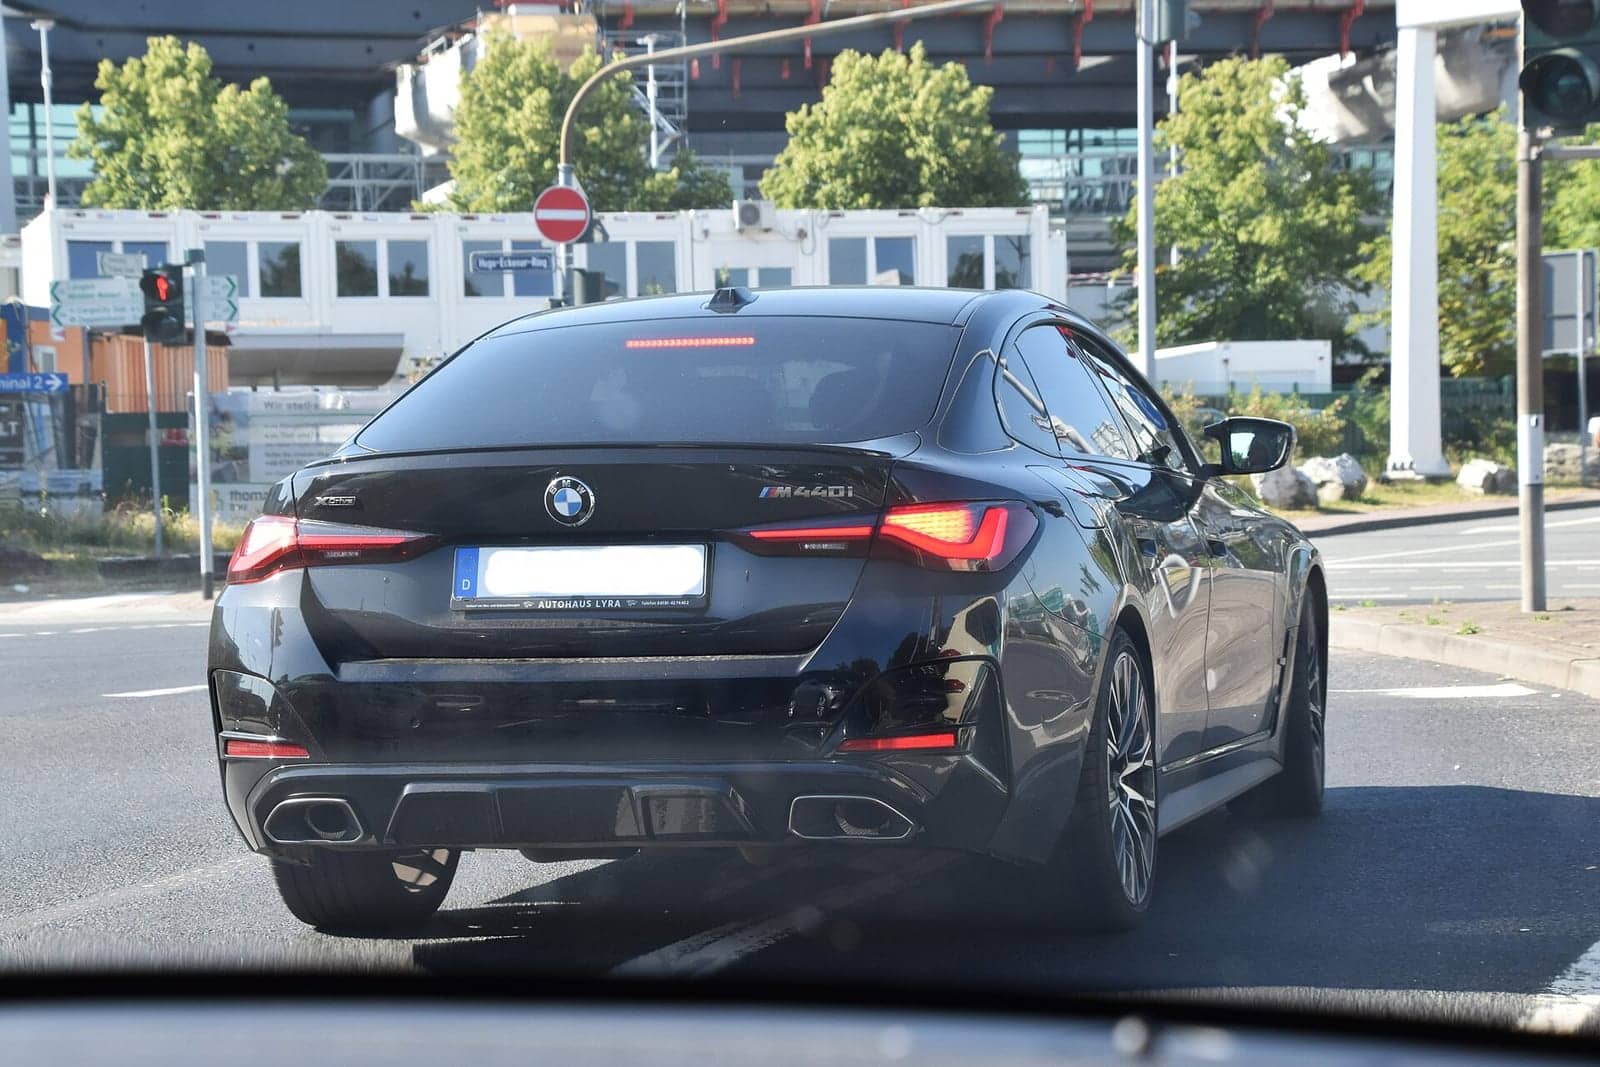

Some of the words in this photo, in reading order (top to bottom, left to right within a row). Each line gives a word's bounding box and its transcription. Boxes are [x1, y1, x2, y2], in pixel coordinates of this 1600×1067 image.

[34, 376, 43, 390] 2
[549, 479, 587, 495] BMW
[774, 486, 854, 498] M440i
[462, 578, 471, 591] D
[537, 600, 592, 609] AUTOHAUS
[596, 599, 621, 608] LYRA
